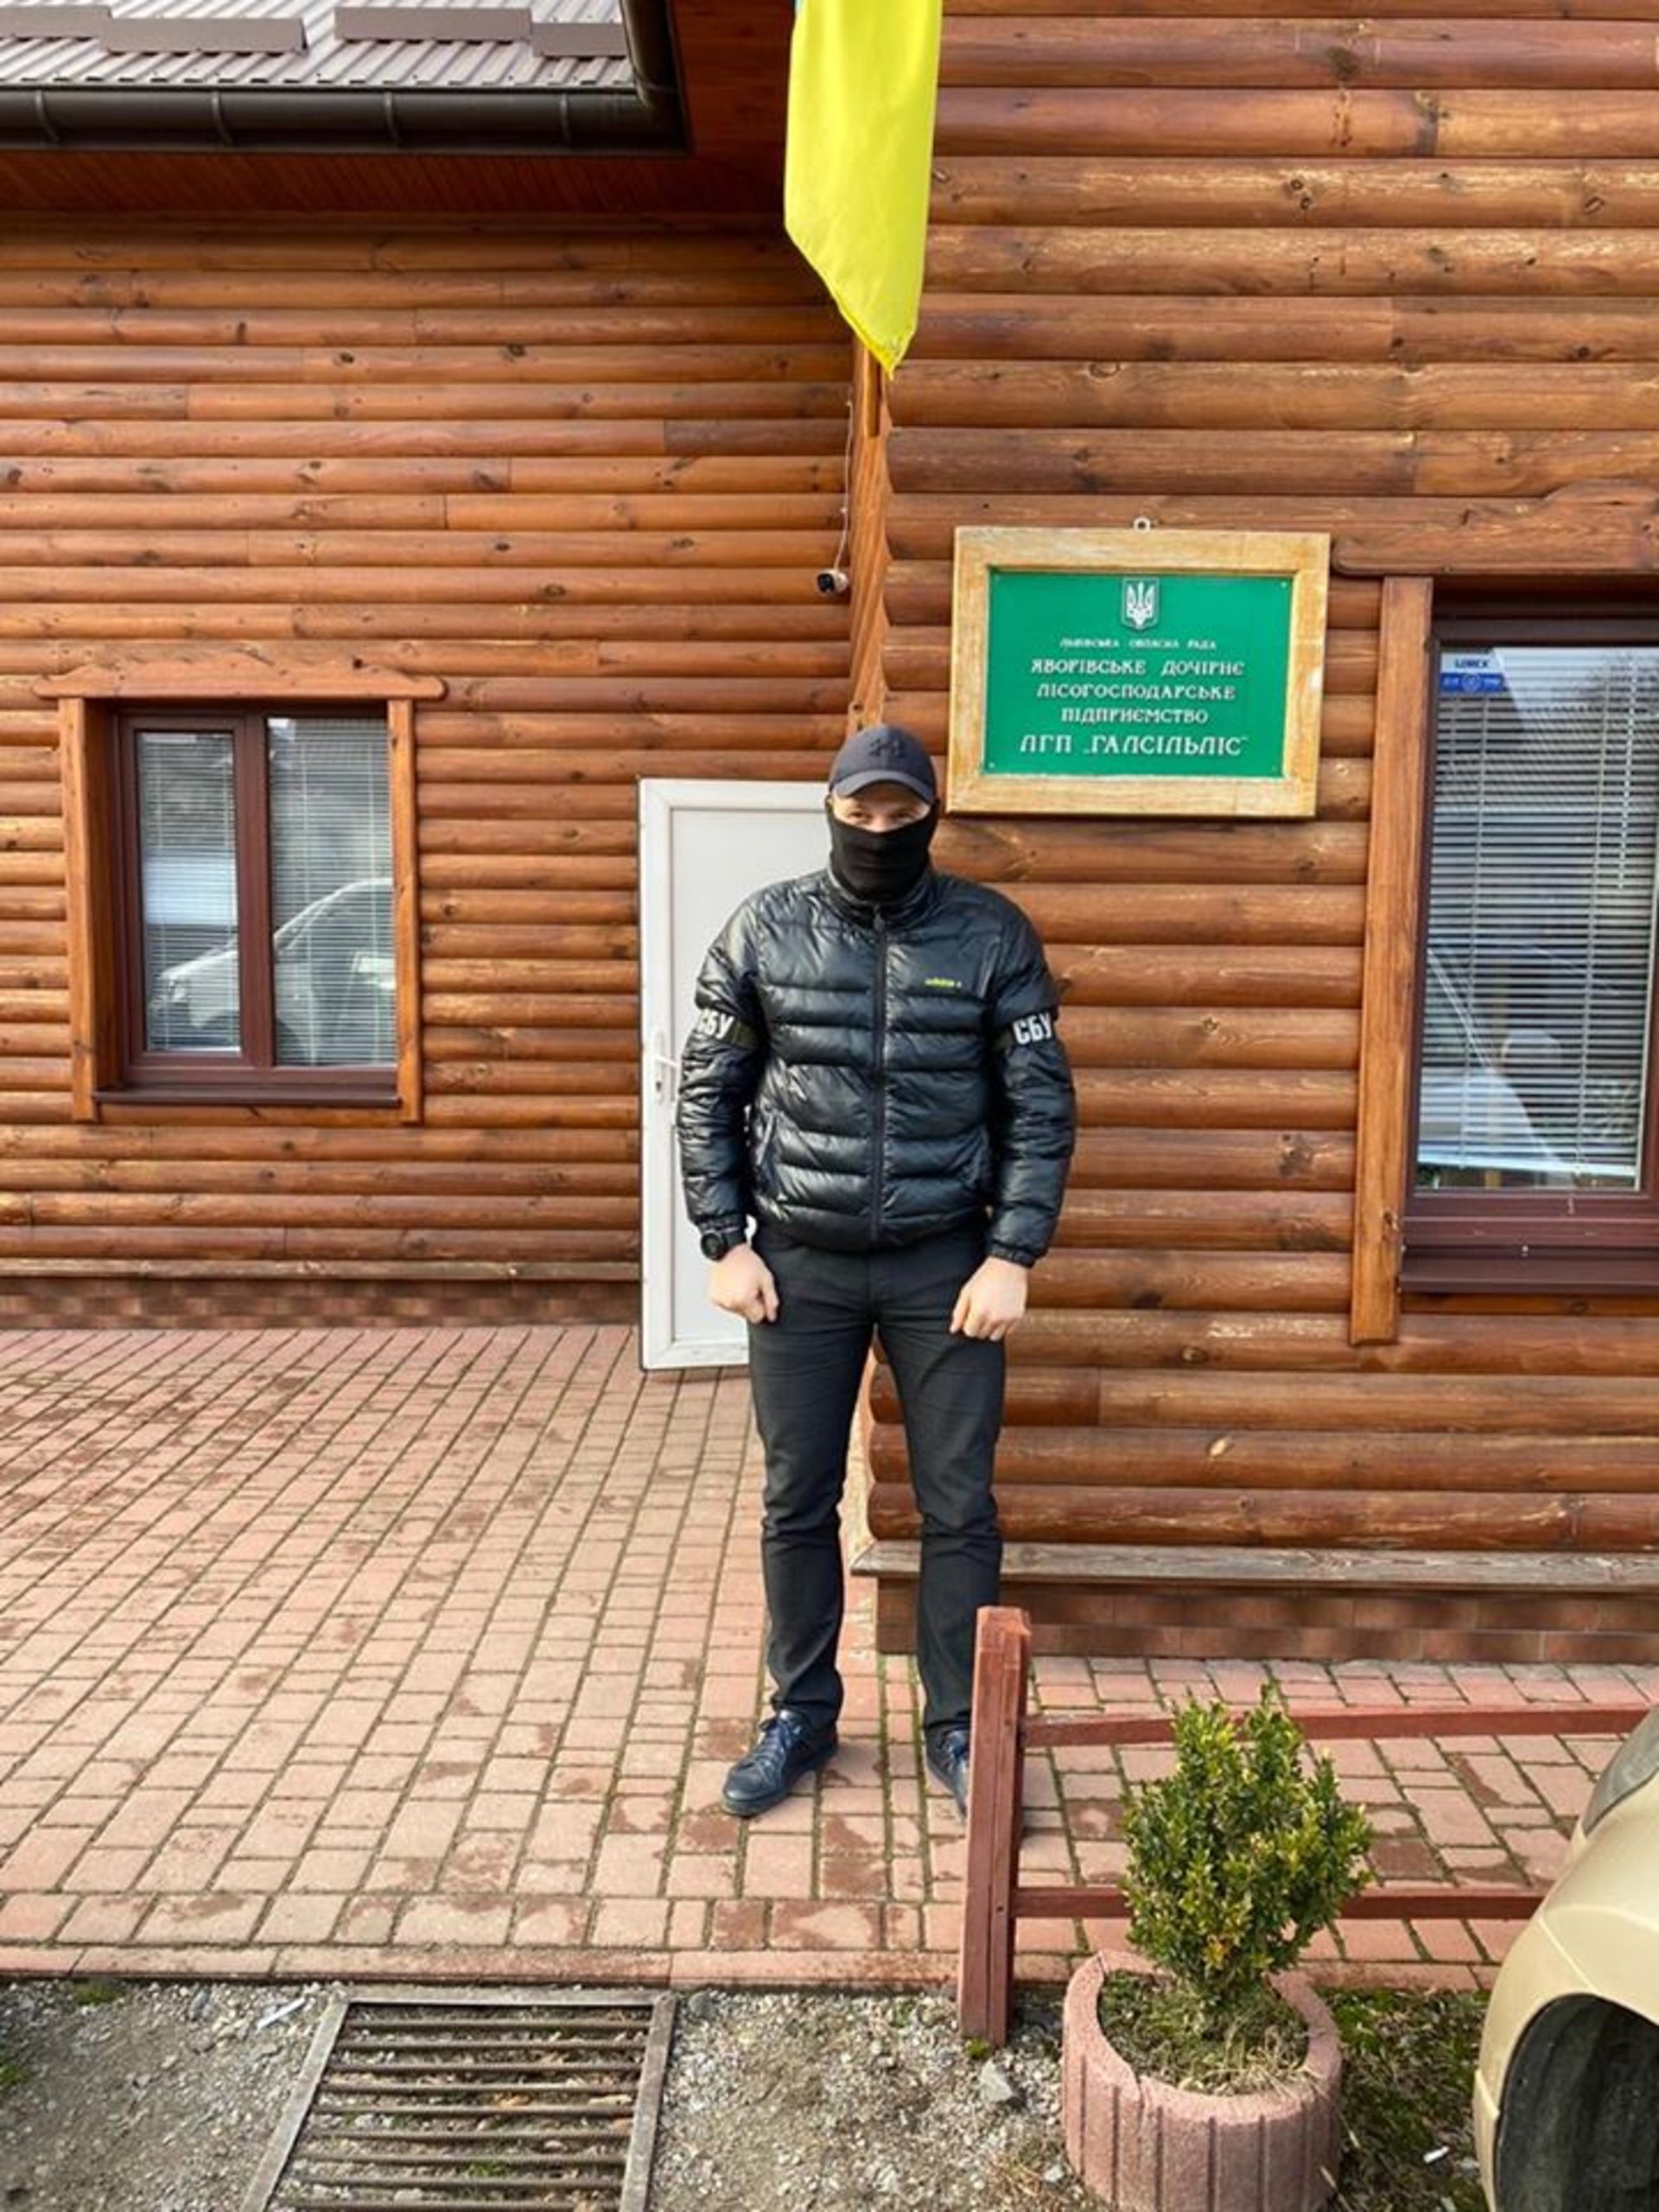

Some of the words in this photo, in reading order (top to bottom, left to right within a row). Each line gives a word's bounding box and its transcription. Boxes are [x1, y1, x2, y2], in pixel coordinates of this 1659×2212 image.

[1031, 658, 1147, 675] ЯВОРІВСЬКЕ
[1161, 660, 1245, 677] ДОЧІРНЄ
[1037, 683, 1236, 700] ЛІСОГОСПОДАРСЬКЕ
[1061, 707, 1209, 724] ПІДПРИЄМСТВО
[1020, 734, 1072, 753] ЛГП
[1013, 1013, 1052, 1044] СБУ
